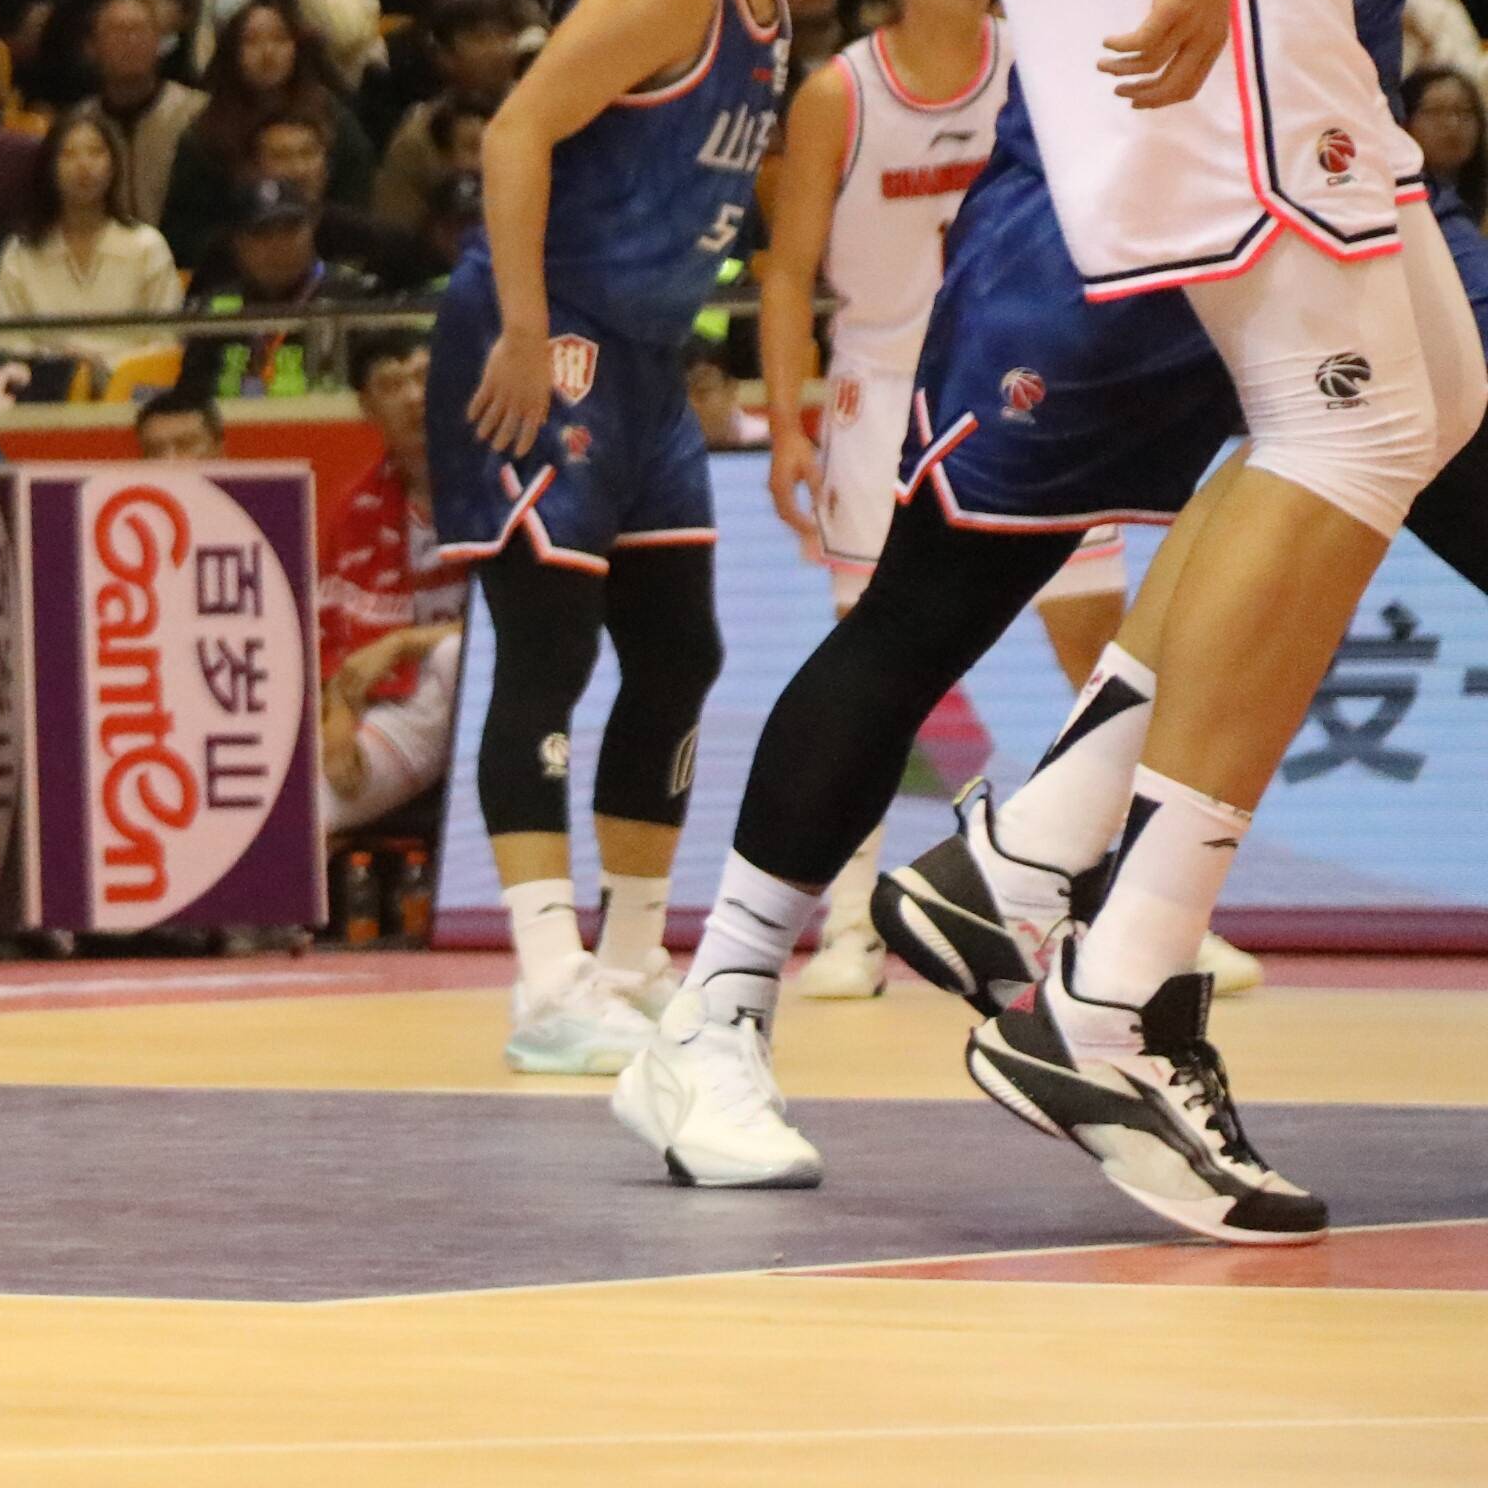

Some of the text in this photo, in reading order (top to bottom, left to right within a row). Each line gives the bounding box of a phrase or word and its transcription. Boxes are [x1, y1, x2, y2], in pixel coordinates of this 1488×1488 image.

[695, 203, 745, 253] 5
[195, 541, 270, 809] 百岁山
